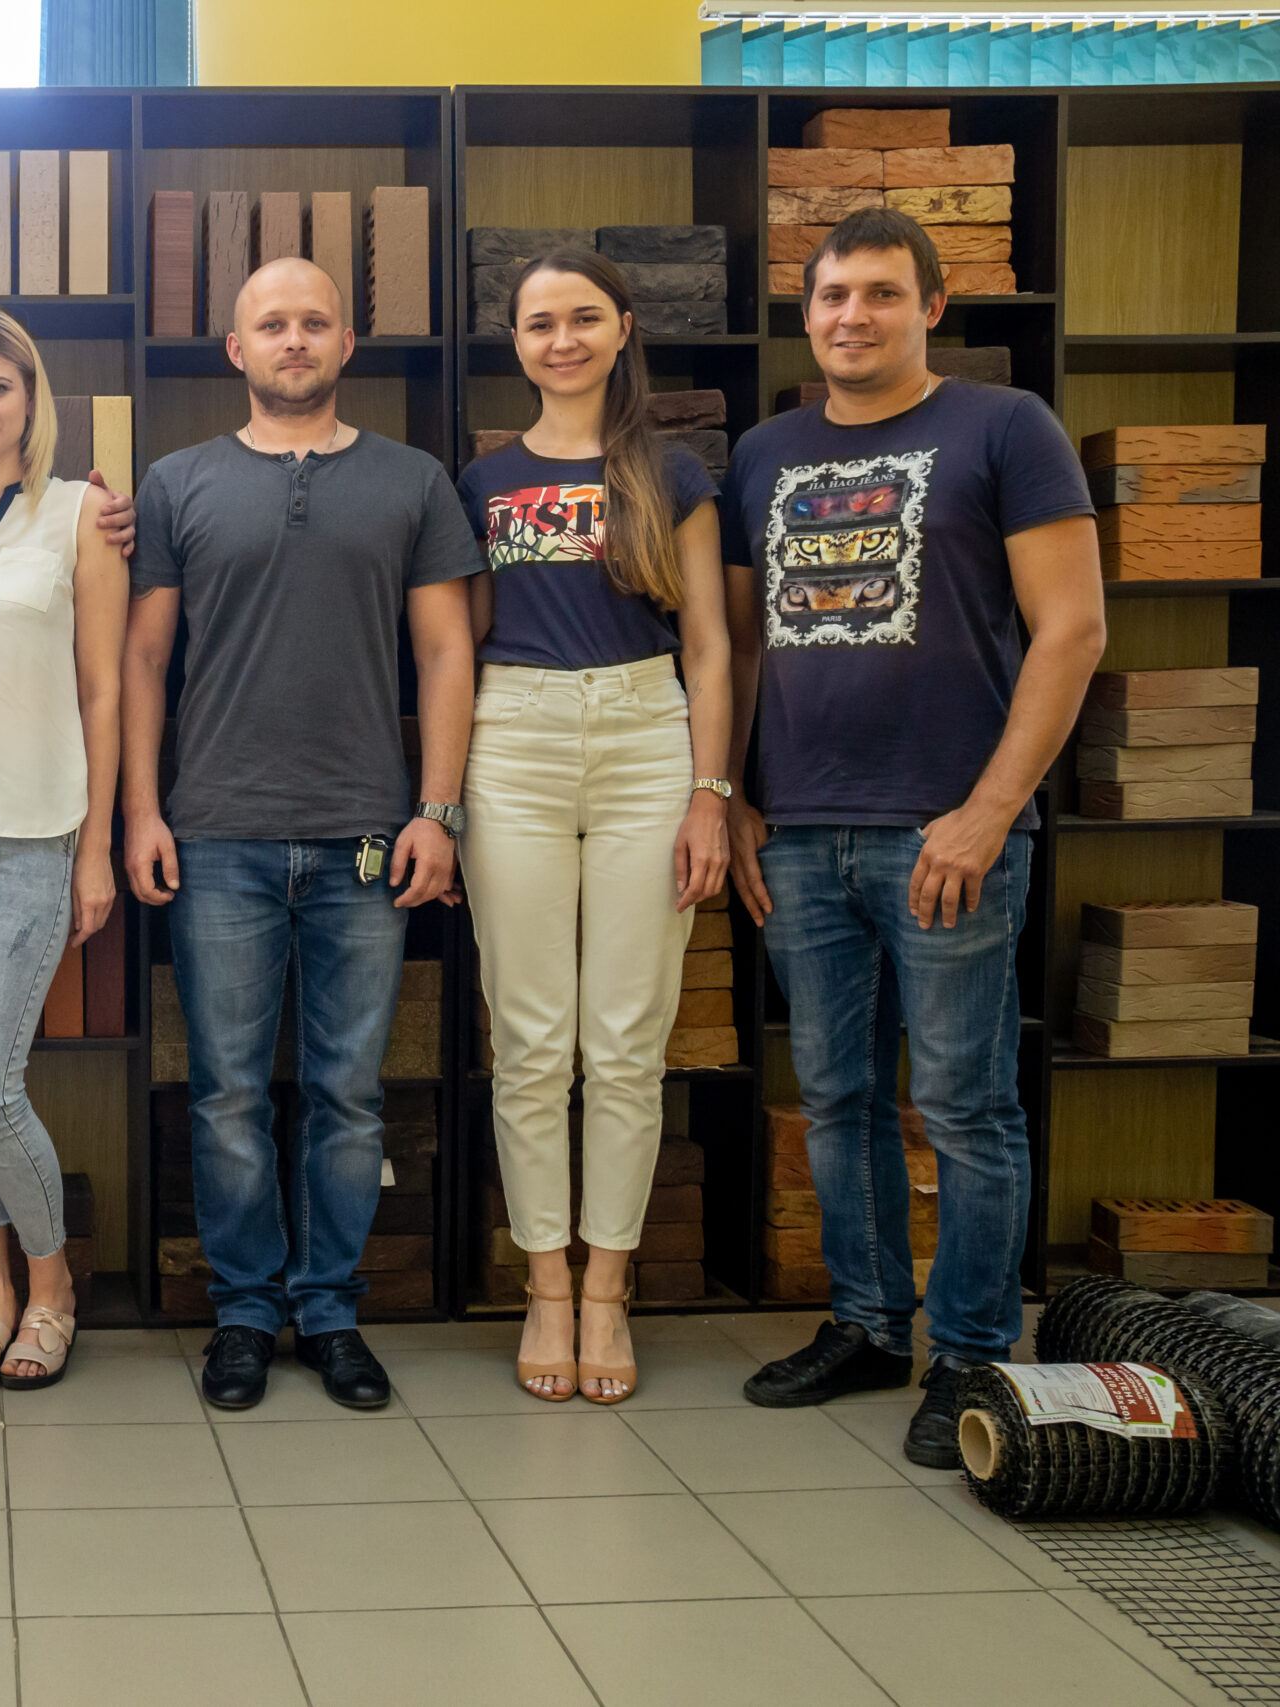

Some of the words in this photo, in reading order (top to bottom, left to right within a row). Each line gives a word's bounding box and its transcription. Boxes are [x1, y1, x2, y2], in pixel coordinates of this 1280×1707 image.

[807, 482, 825, 491] JIA
[828, 479, 856, 489] HAO
[857, 473, 897, 486] JEANS
